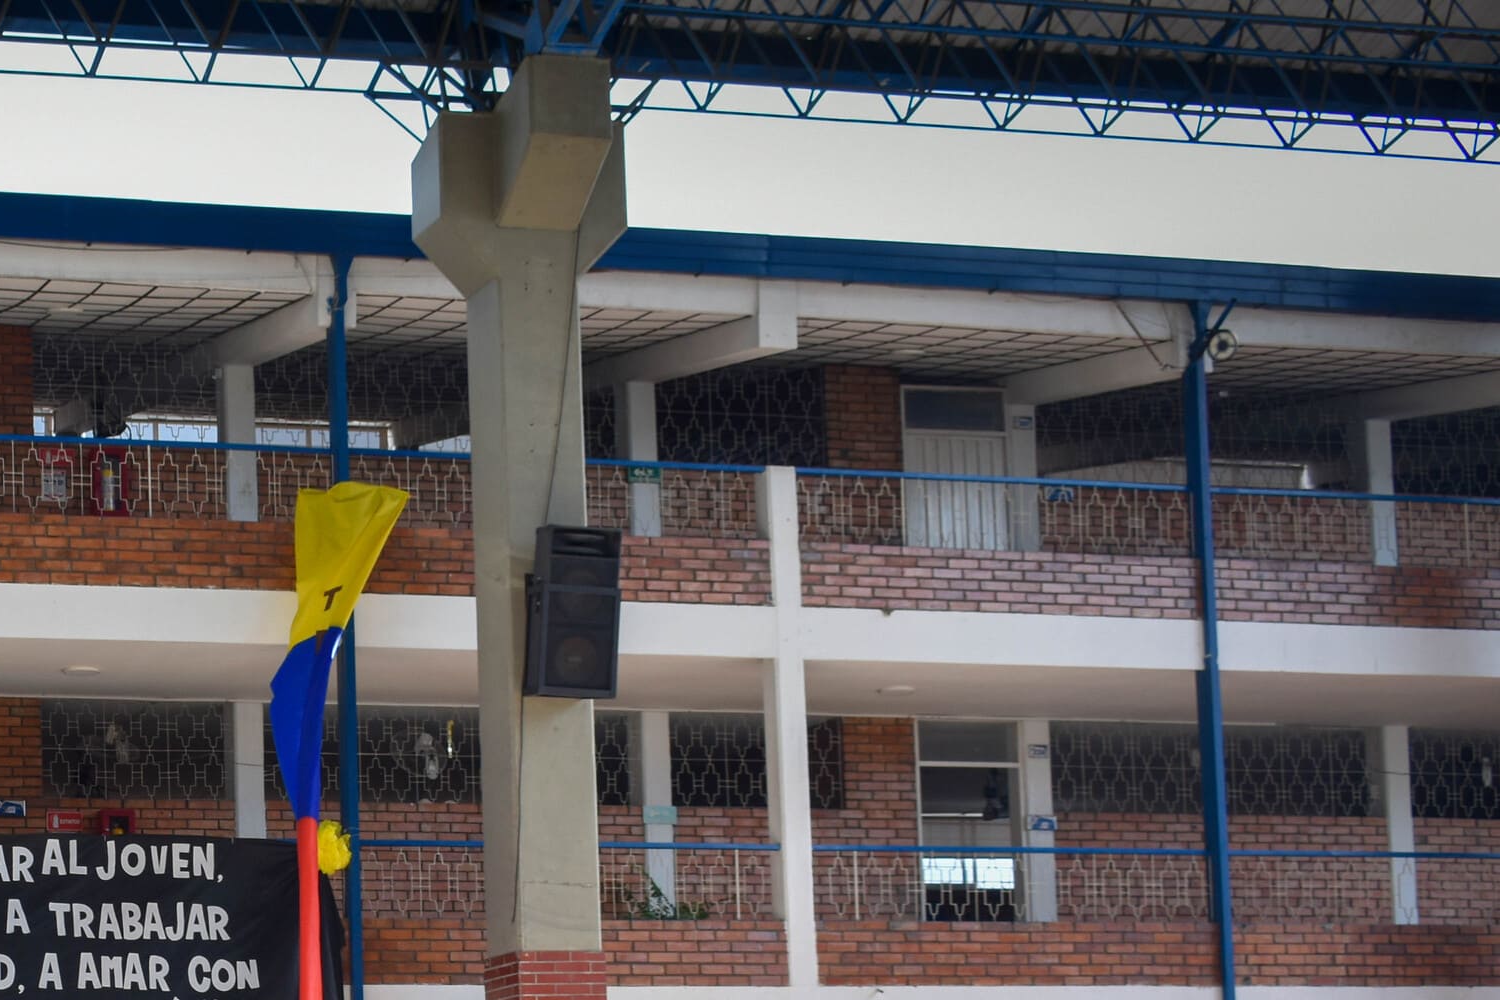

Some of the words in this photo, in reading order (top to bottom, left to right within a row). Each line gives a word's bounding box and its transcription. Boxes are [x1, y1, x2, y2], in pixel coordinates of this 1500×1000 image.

[41, 838, 88, 876] AL
[96, 840, 224, 883] JOVEN,
[5, 898, 31, 935] A
[49, 901, 231, 942] TRABAJAR
[38, 952, 64, 991] A
[77, 952, 171, 992] AMAR
[188, 954, 261, 993] CON
